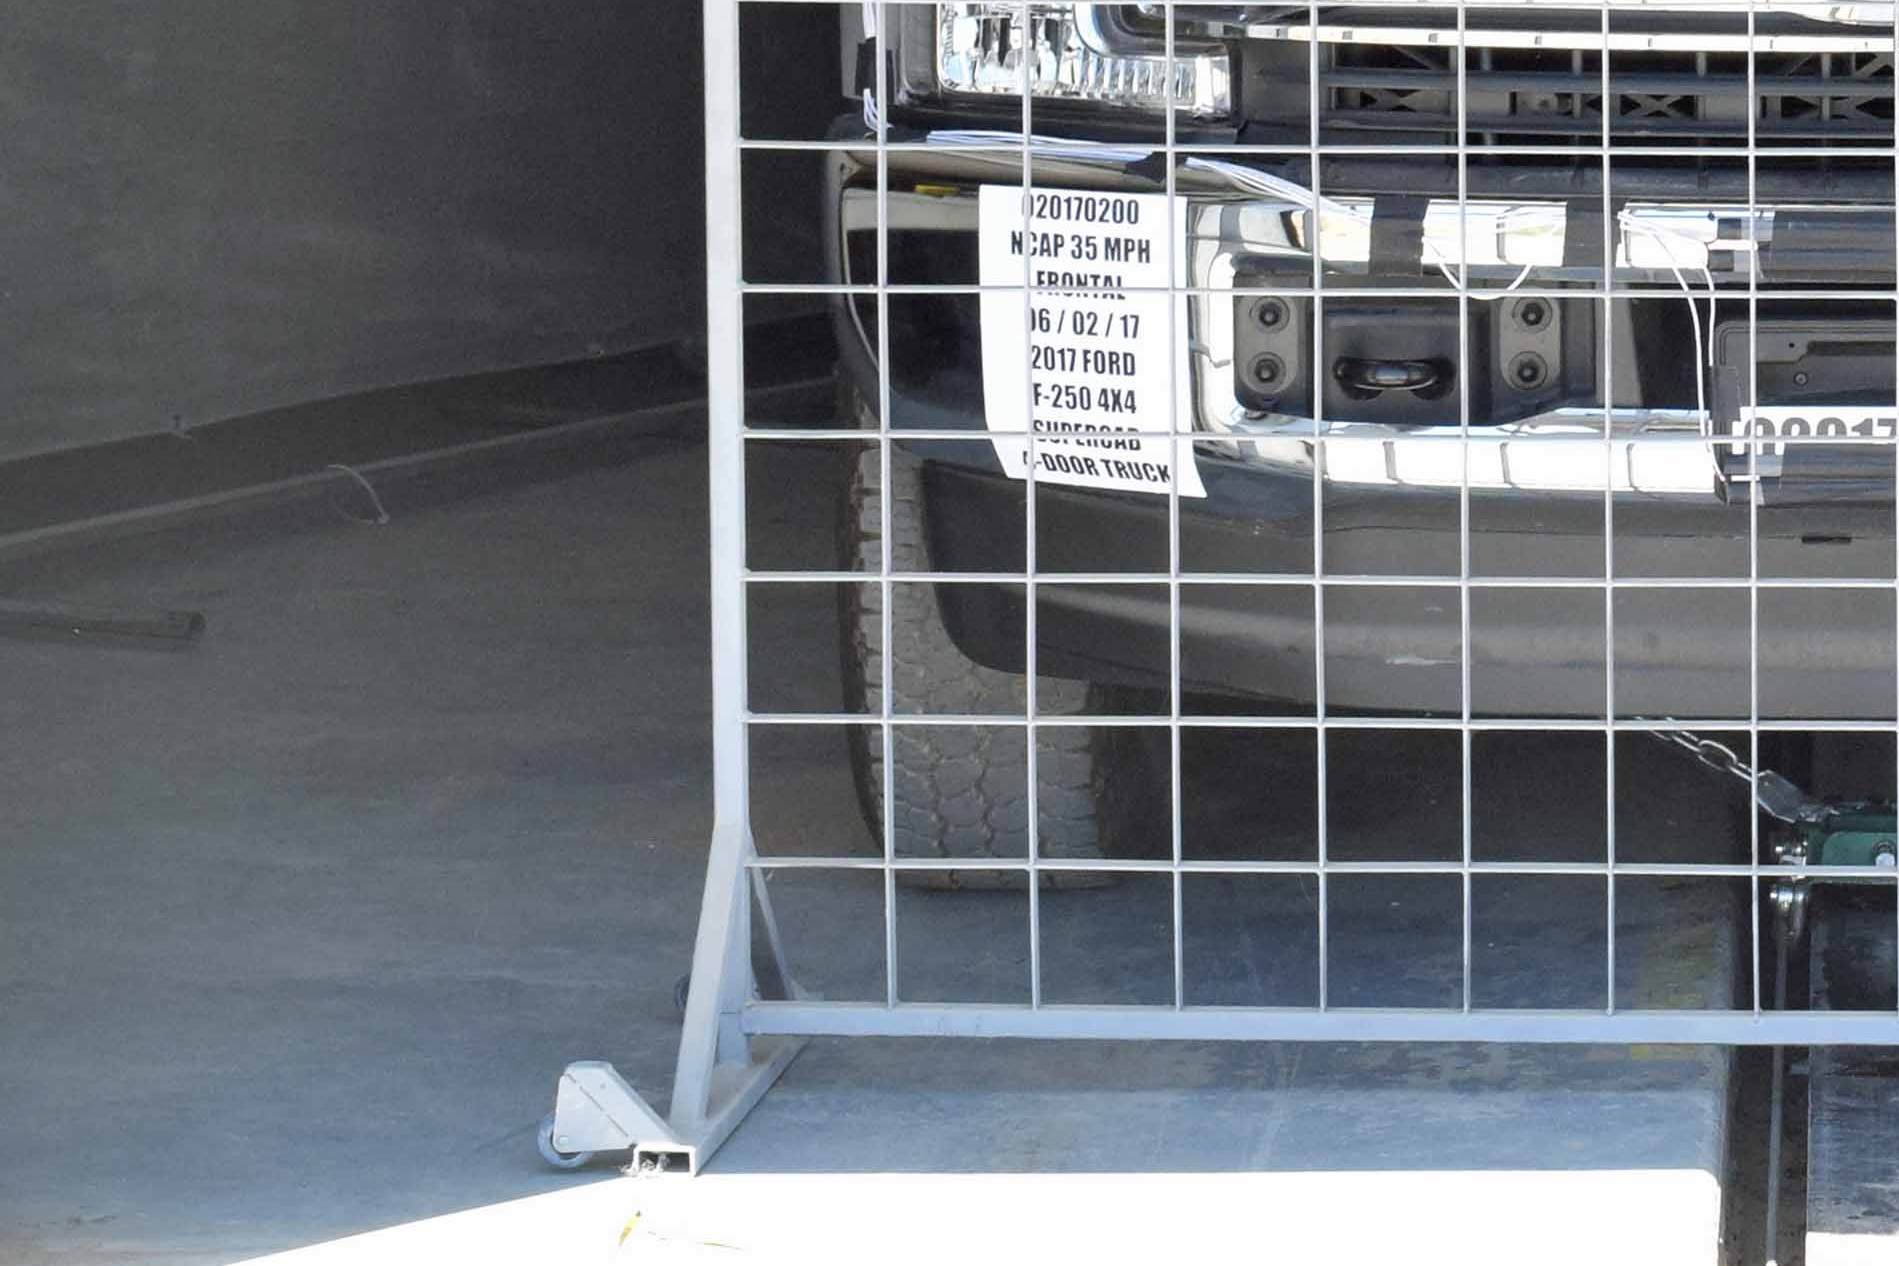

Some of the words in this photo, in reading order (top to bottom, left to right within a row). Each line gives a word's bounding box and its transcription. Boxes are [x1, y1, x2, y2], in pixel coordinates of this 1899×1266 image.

[1010, 230, 1065, 258] NCAP
[1070, 234, 1098, 261] 35
[1103, 236, 1151, 264] MPH
[1036, 270, 1126, 301] FRONTAL
[1072, 310, 1099, 336] 02
[1119, 314, 1140, 339] 17
[1031, 344, 1077, 373] 2017
[1082, 348, 1136, 377] FORD
[1032, 382, 1092, 411] F-250
[1097, 387, 1137, 415] 4X4
[1033, 419, 1142, 452] SUPERCAB
[1099, 458, 1171, 484] TRUCK
